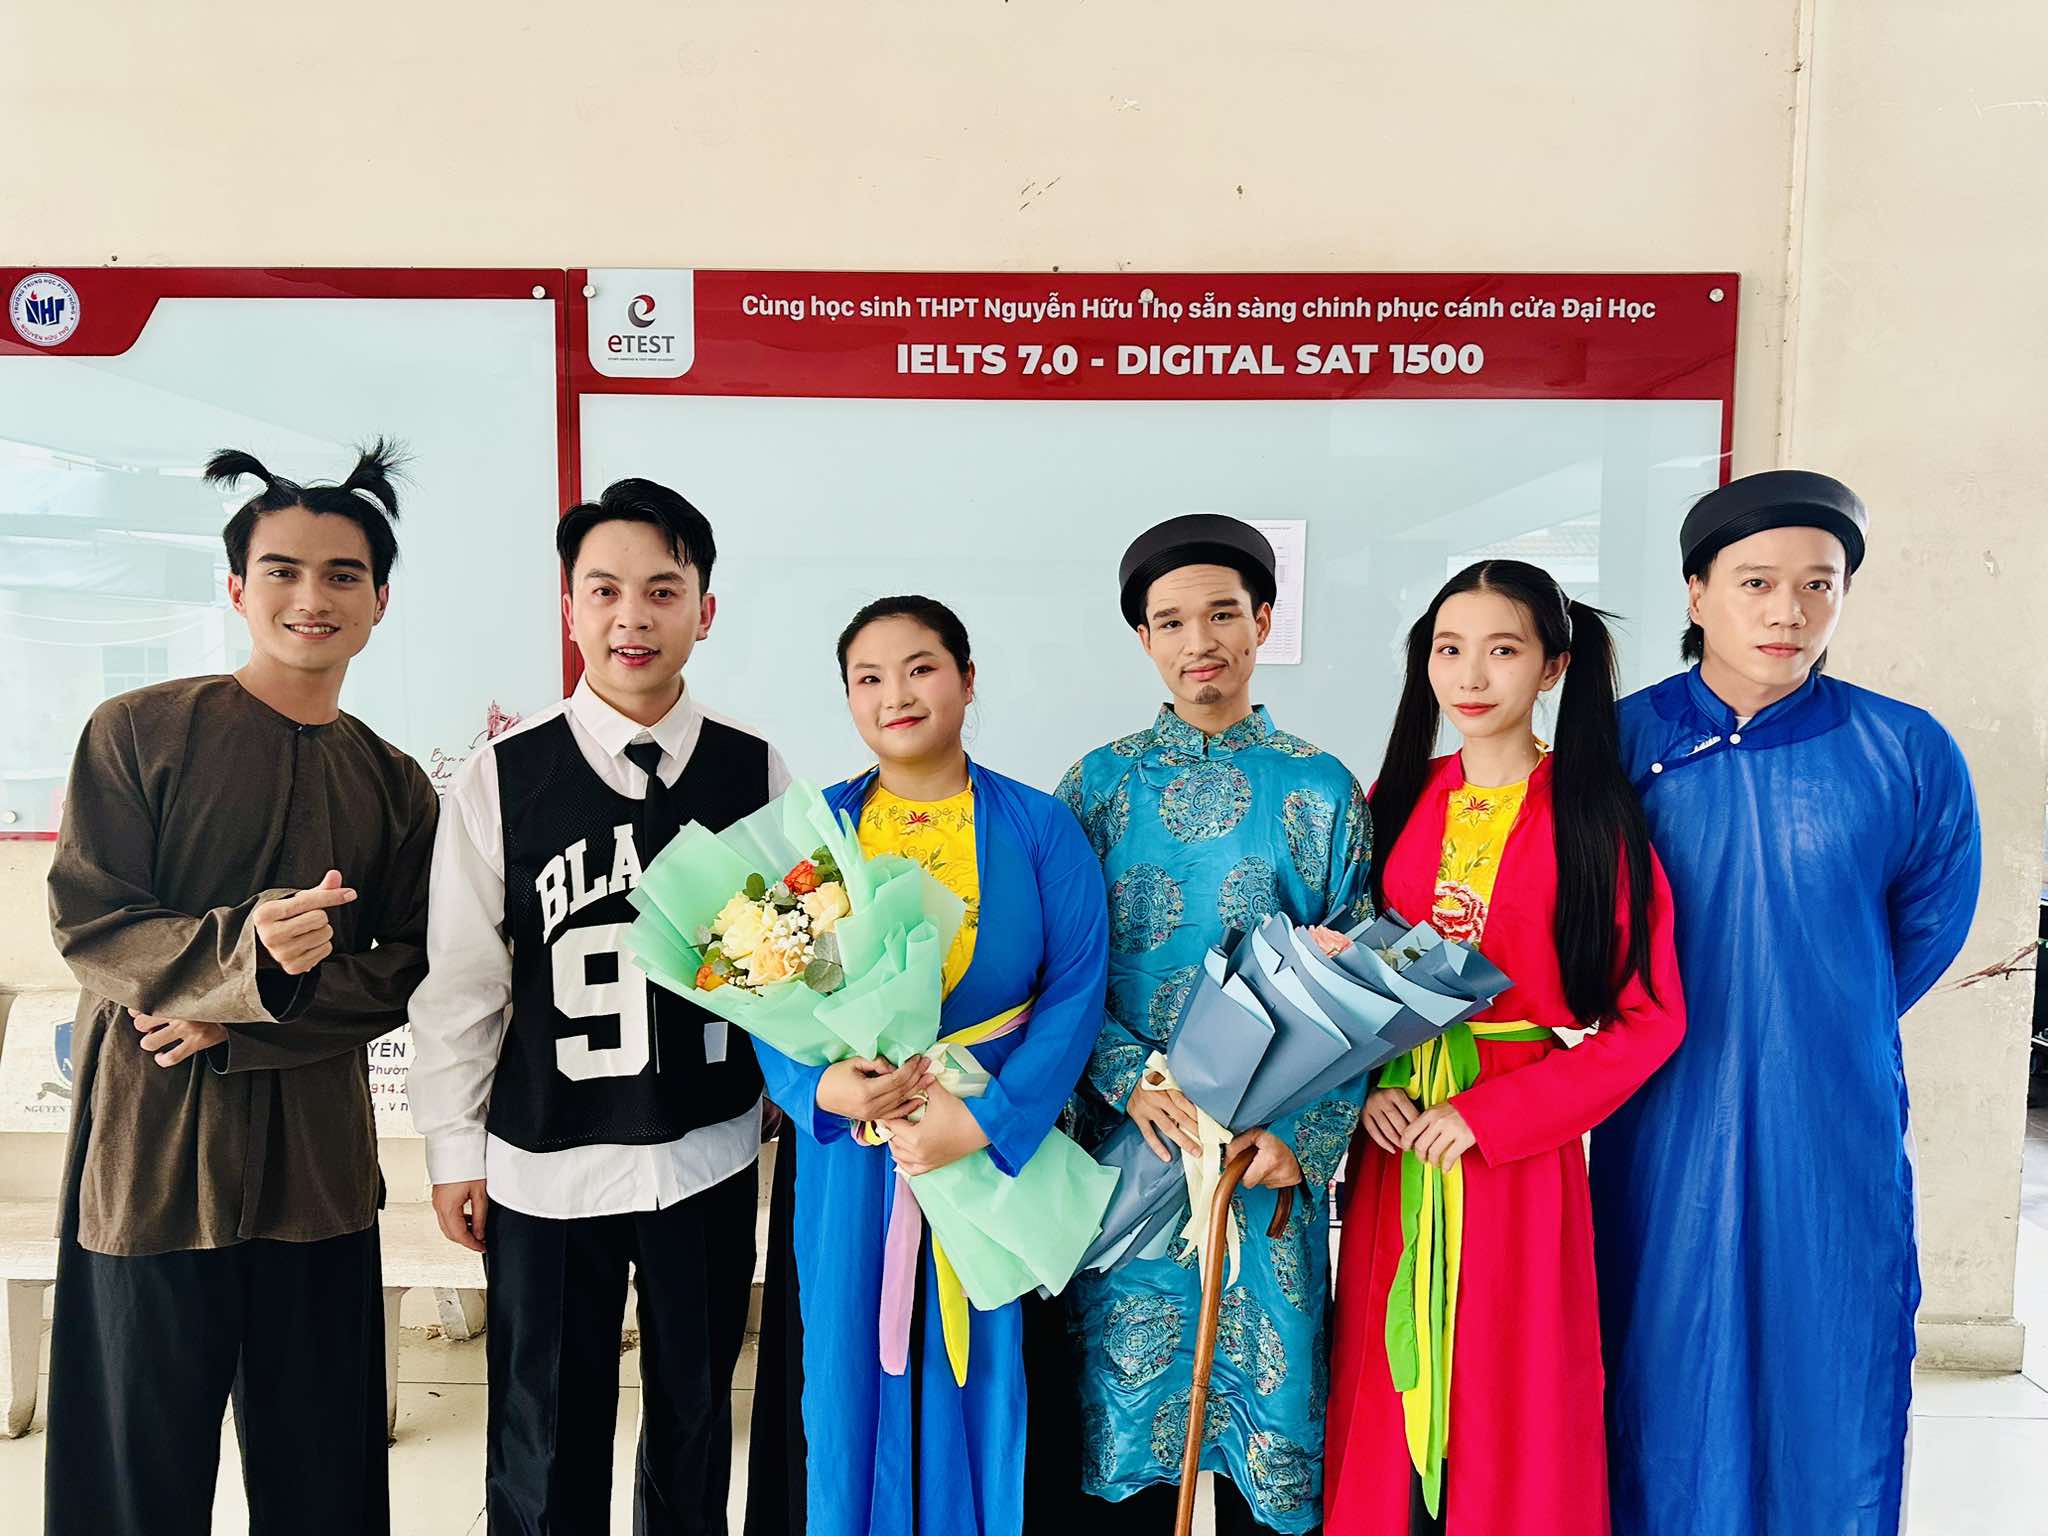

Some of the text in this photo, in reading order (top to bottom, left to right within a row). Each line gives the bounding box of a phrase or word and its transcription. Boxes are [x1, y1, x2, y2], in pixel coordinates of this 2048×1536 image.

[742, 292, 1656, 323] Cùng học sinh THPT Nguyễn Hữu Thọ sẵn sàng chinh phục cánh cửa Đại Học
[608, 335, 675, 353] eTEST
[897, 343, 1485, 375] IELTS 7.0 - DIGITAL SAT 1500
